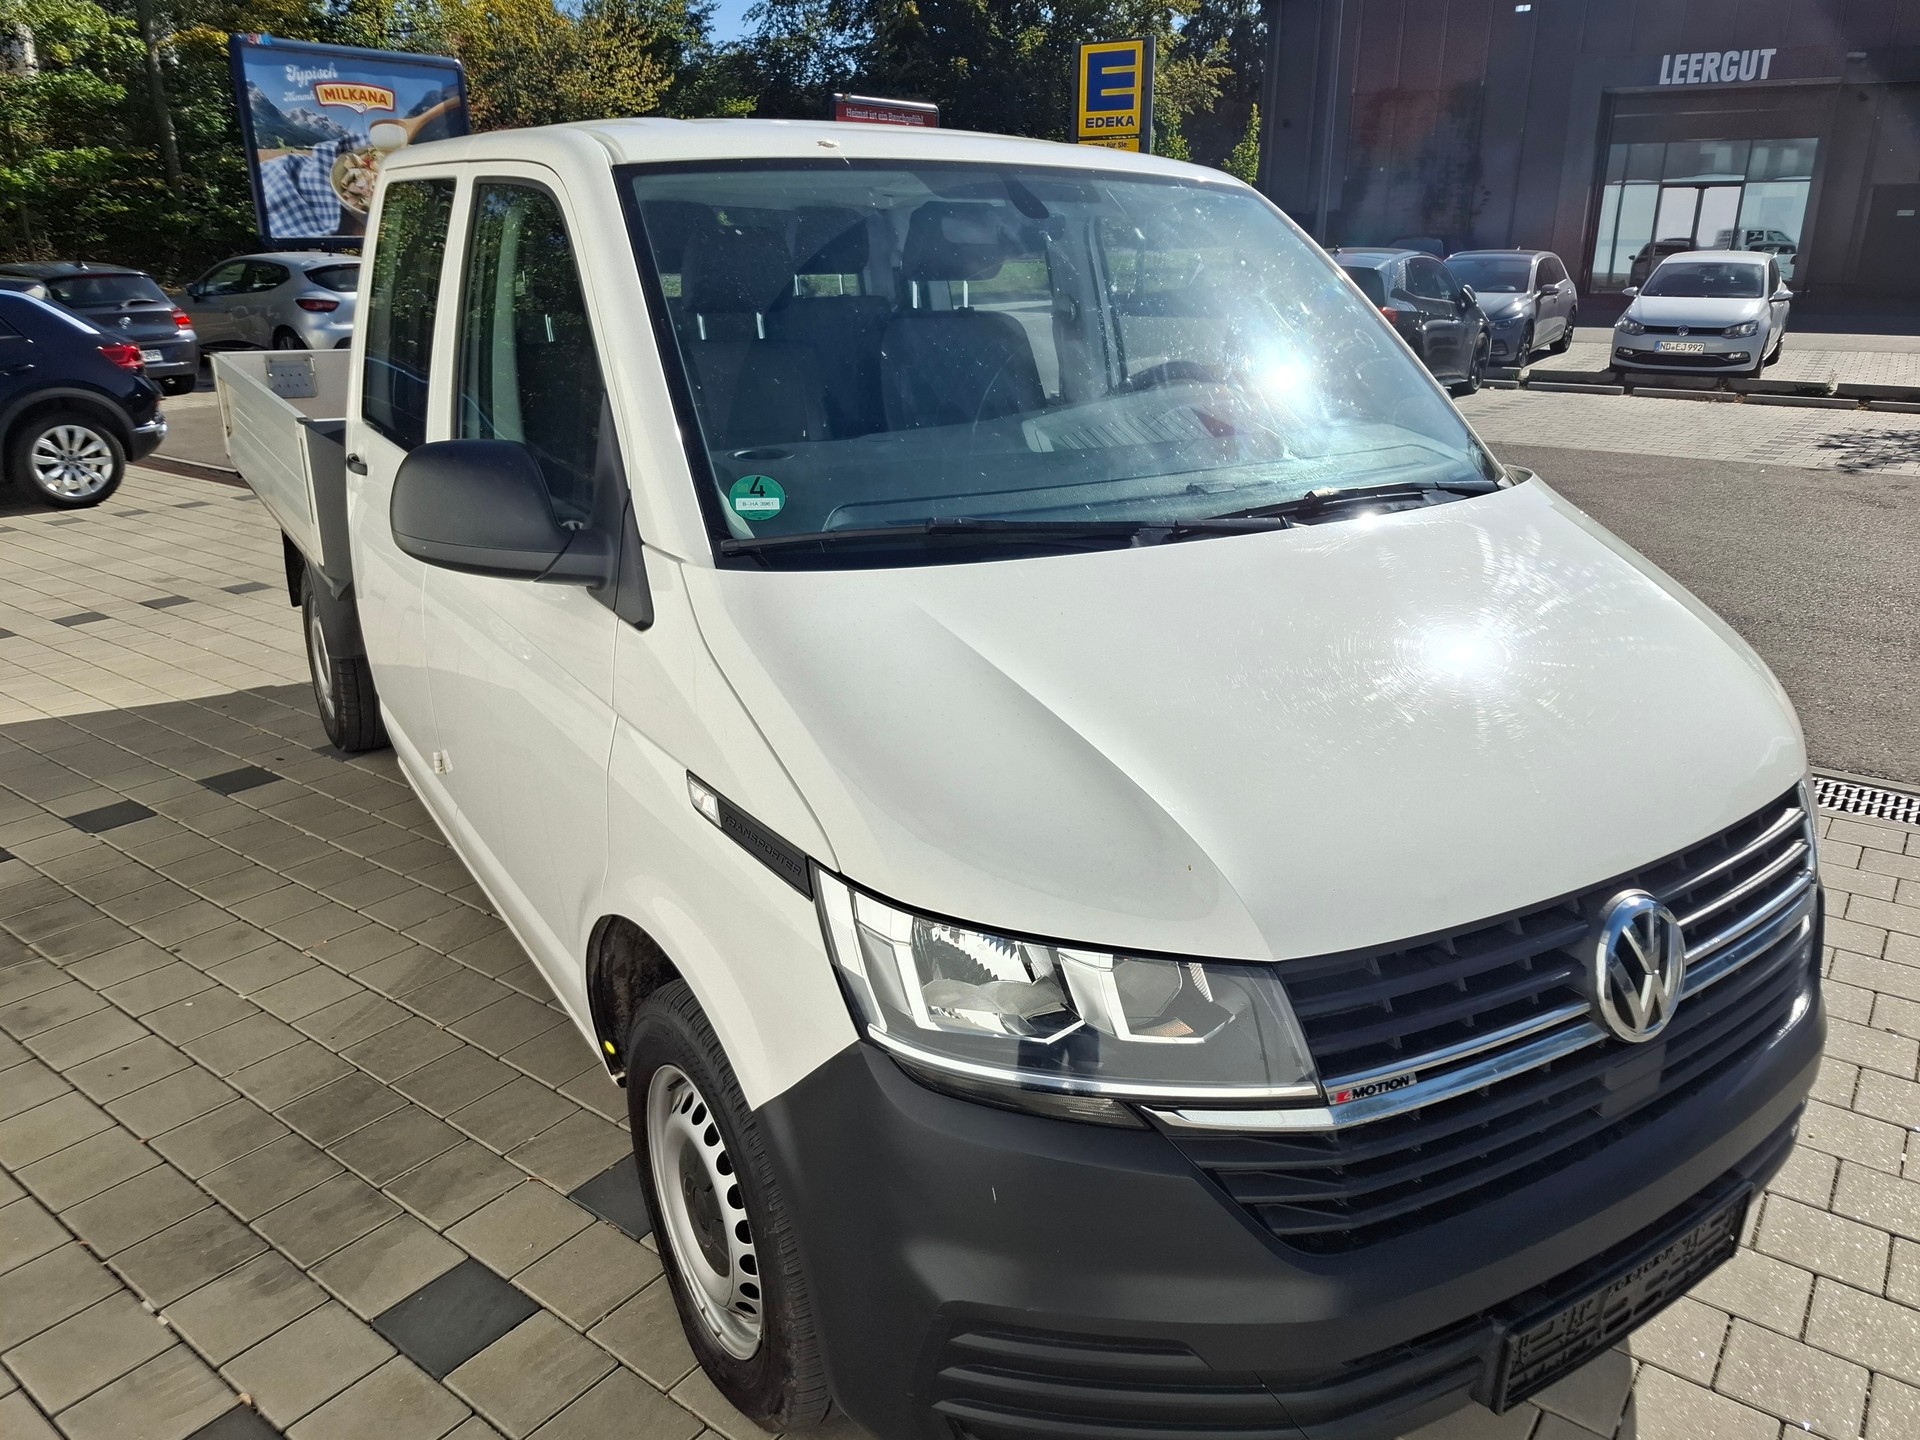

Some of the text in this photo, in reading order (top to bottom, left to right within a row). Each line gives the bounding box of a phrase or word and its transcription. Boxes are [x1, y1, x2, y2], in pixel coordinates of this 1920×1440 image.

[285, 62, 338, 87] Typisch
[1659, 48, 1777, 85] LEERGUT
[323, 87, 389, 105] MILKANA
[846, 107, 868, 119] Heimat
[869, 110, 877, 120] ist
[878, 112, 887, 120] ein
[1085, 115, 1135, 129] EDEKA
[749, 475, 766, 498] 4
[723, 811, 802, 877] TRANSPORTER
[1337, 1075, 1410, 1104] 4MOTION
